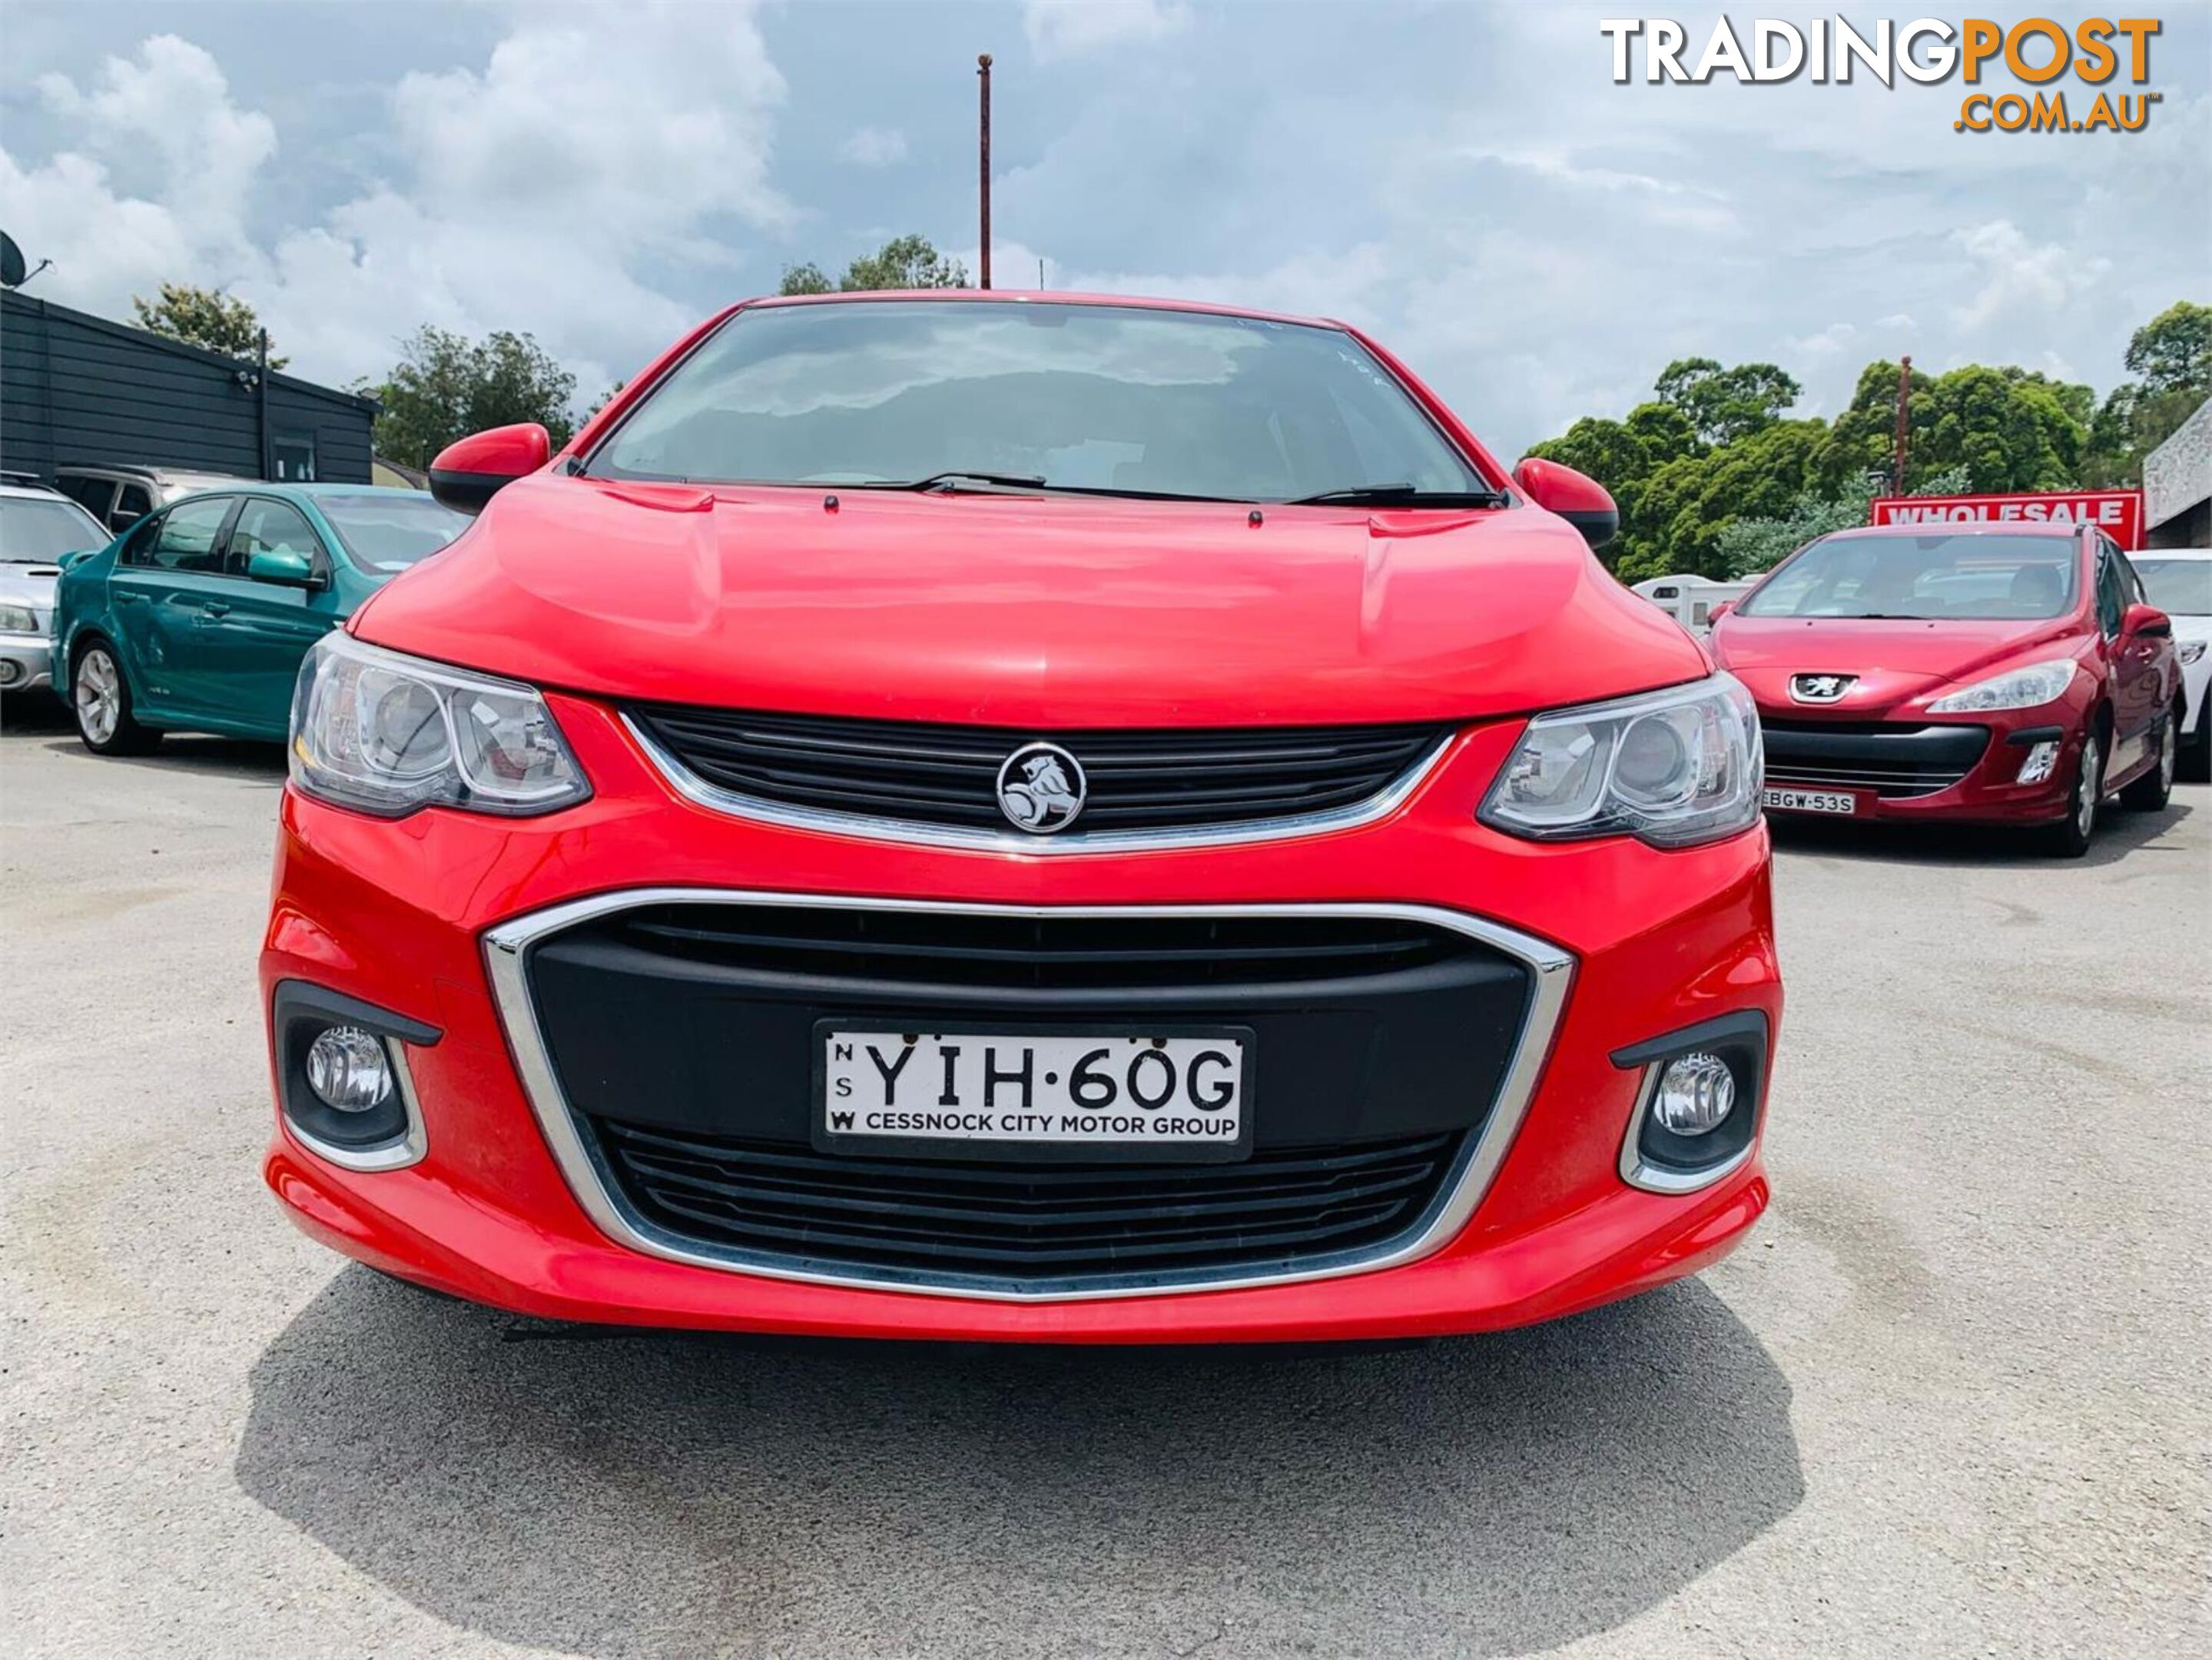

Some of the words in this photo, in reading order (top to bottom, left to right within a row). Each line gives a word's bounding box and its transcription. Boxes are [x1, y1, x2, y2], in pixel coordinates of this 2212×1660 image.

[1888, 501, 2124, 524] WHOLESALE
[866, 1113, 993, 1132] CESSNOCK
[1000, 1114, 1053, 1132] CITY
[1061, 1116, 1146, 1134] MOTOR
[1152, 1117, 1235, 1136] GROUP
